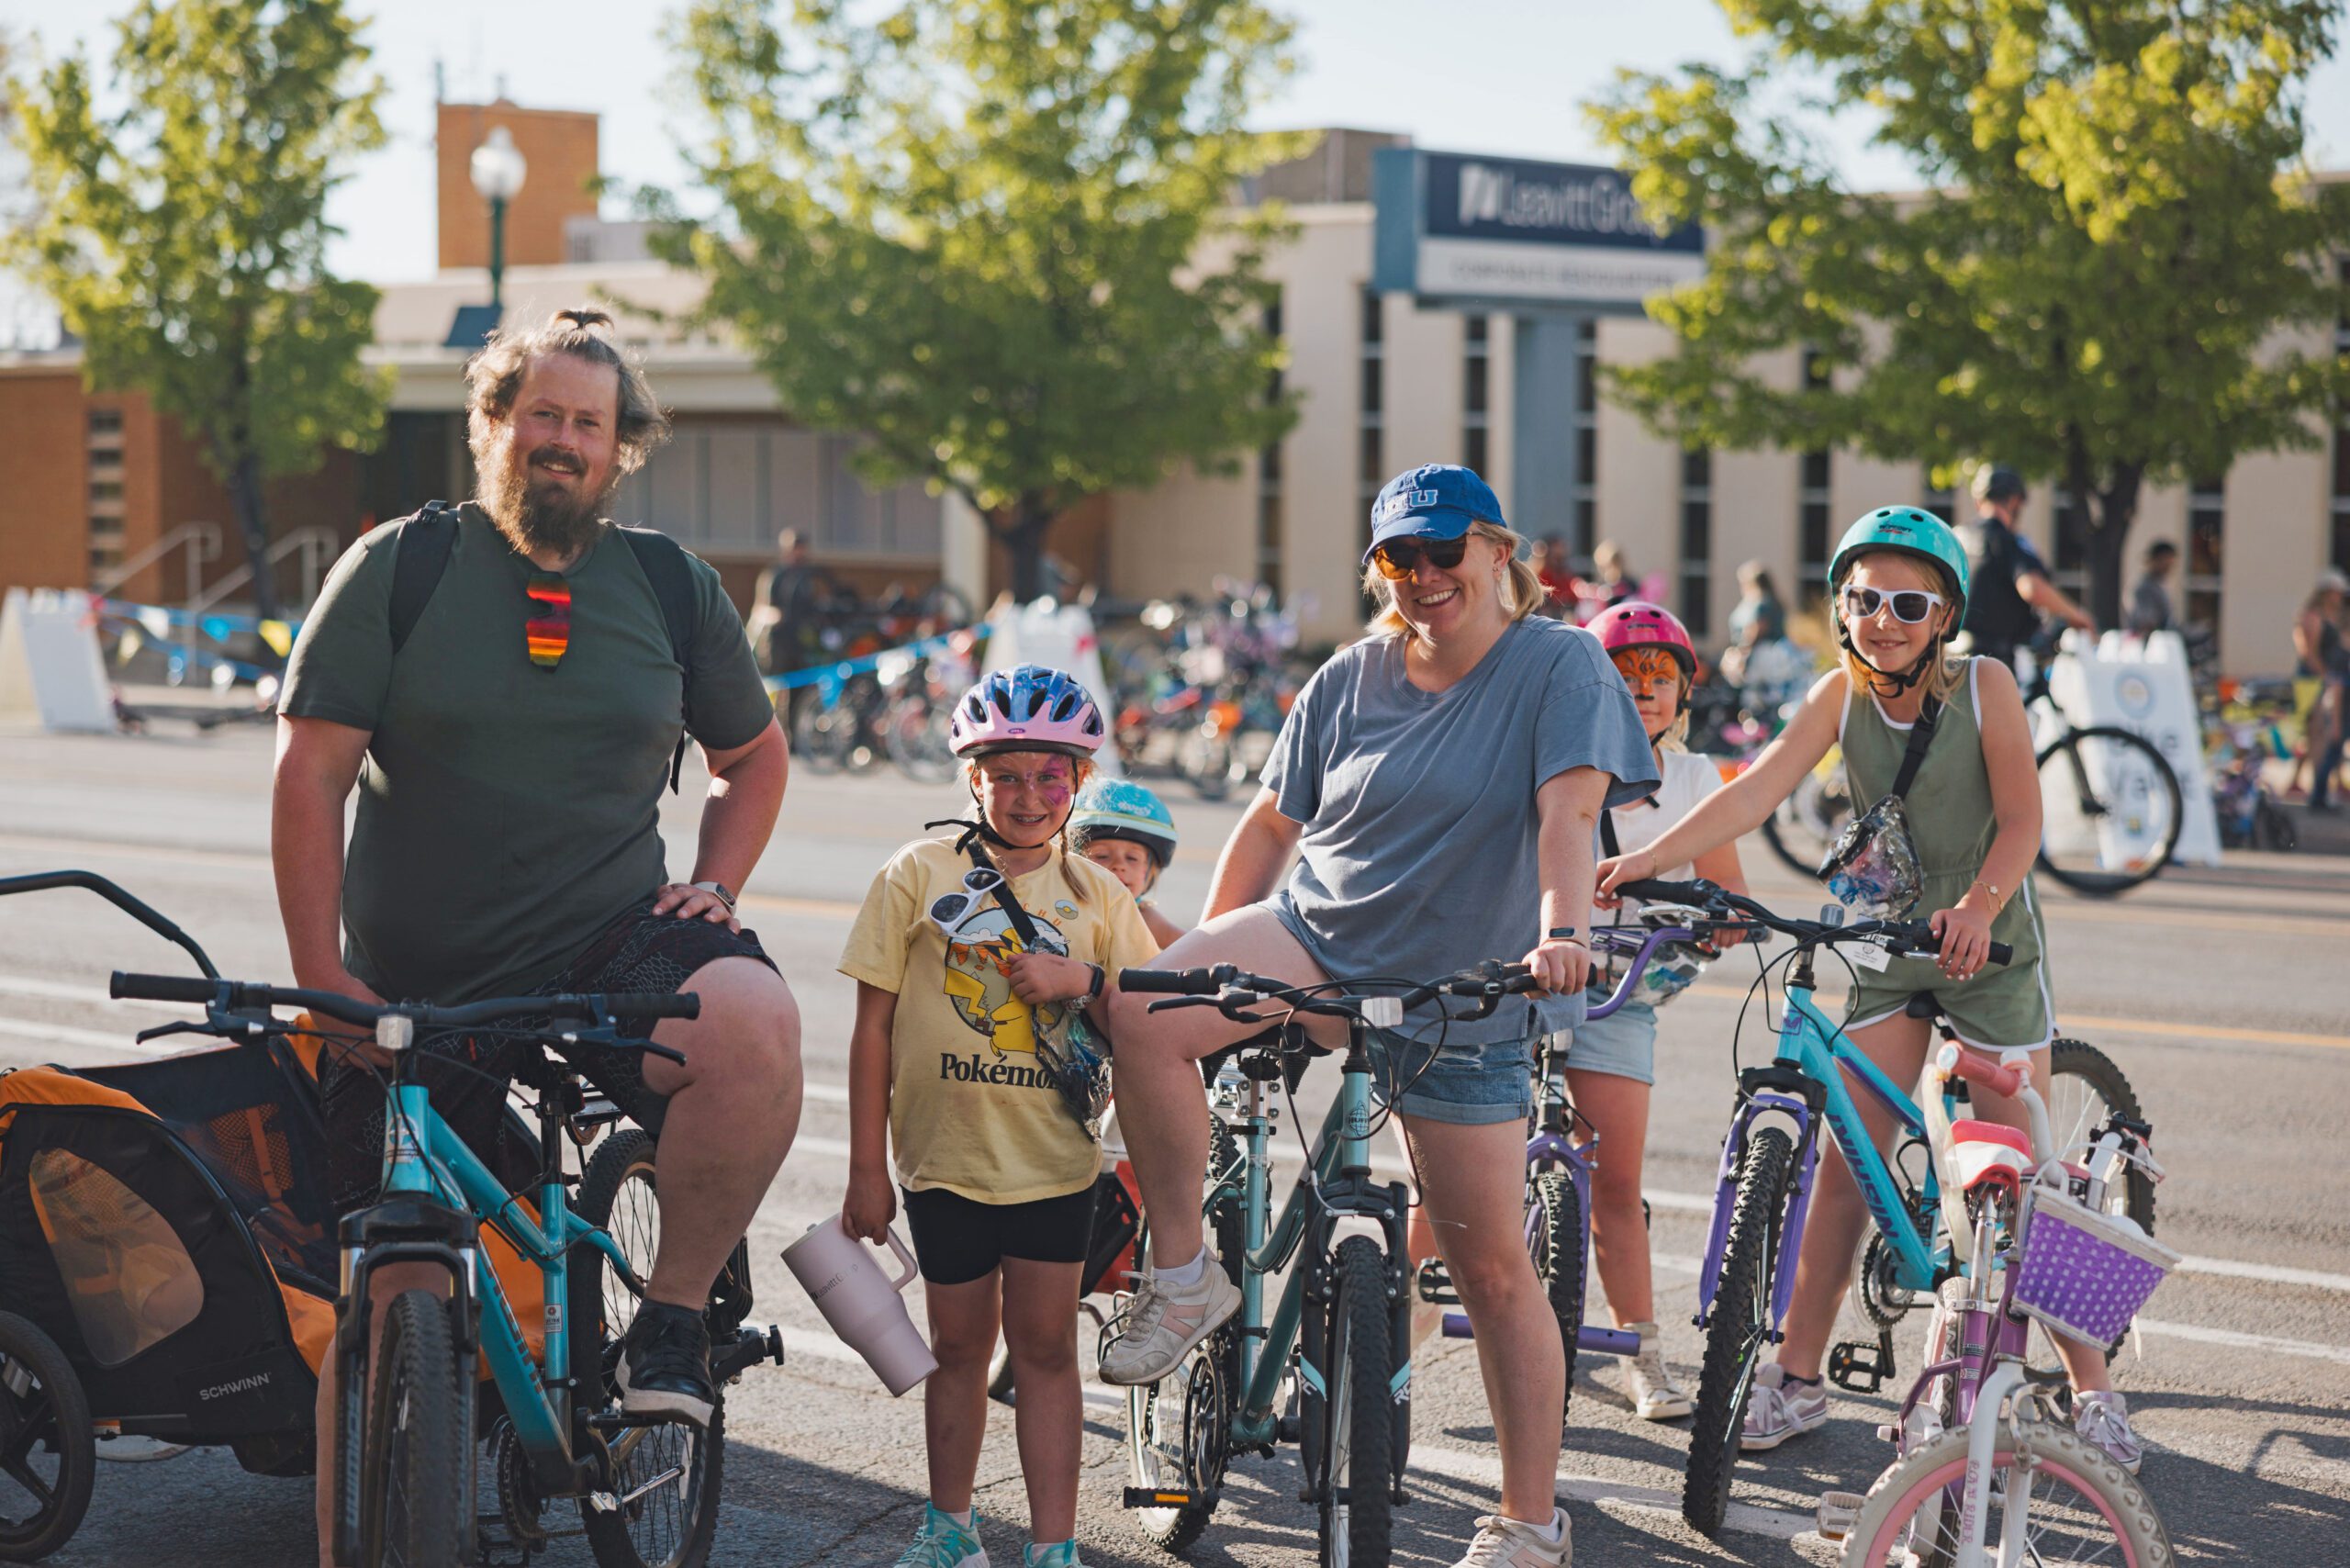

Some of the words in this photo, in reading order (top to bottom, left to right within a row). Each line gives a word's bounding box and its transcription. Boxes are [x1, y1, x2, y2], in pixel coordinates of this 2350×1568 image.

[1500, 168, 1591, 232] Leavitt
[1409, 489, 1438, 508] U
[1827, 1112, 1900, 1239] NISHIKI
[817, 1278, 839, 1298] Leavitt
[835, 1263, 859, 1282] Grp
[199, 1372, 271, 1401] SCHWINN
